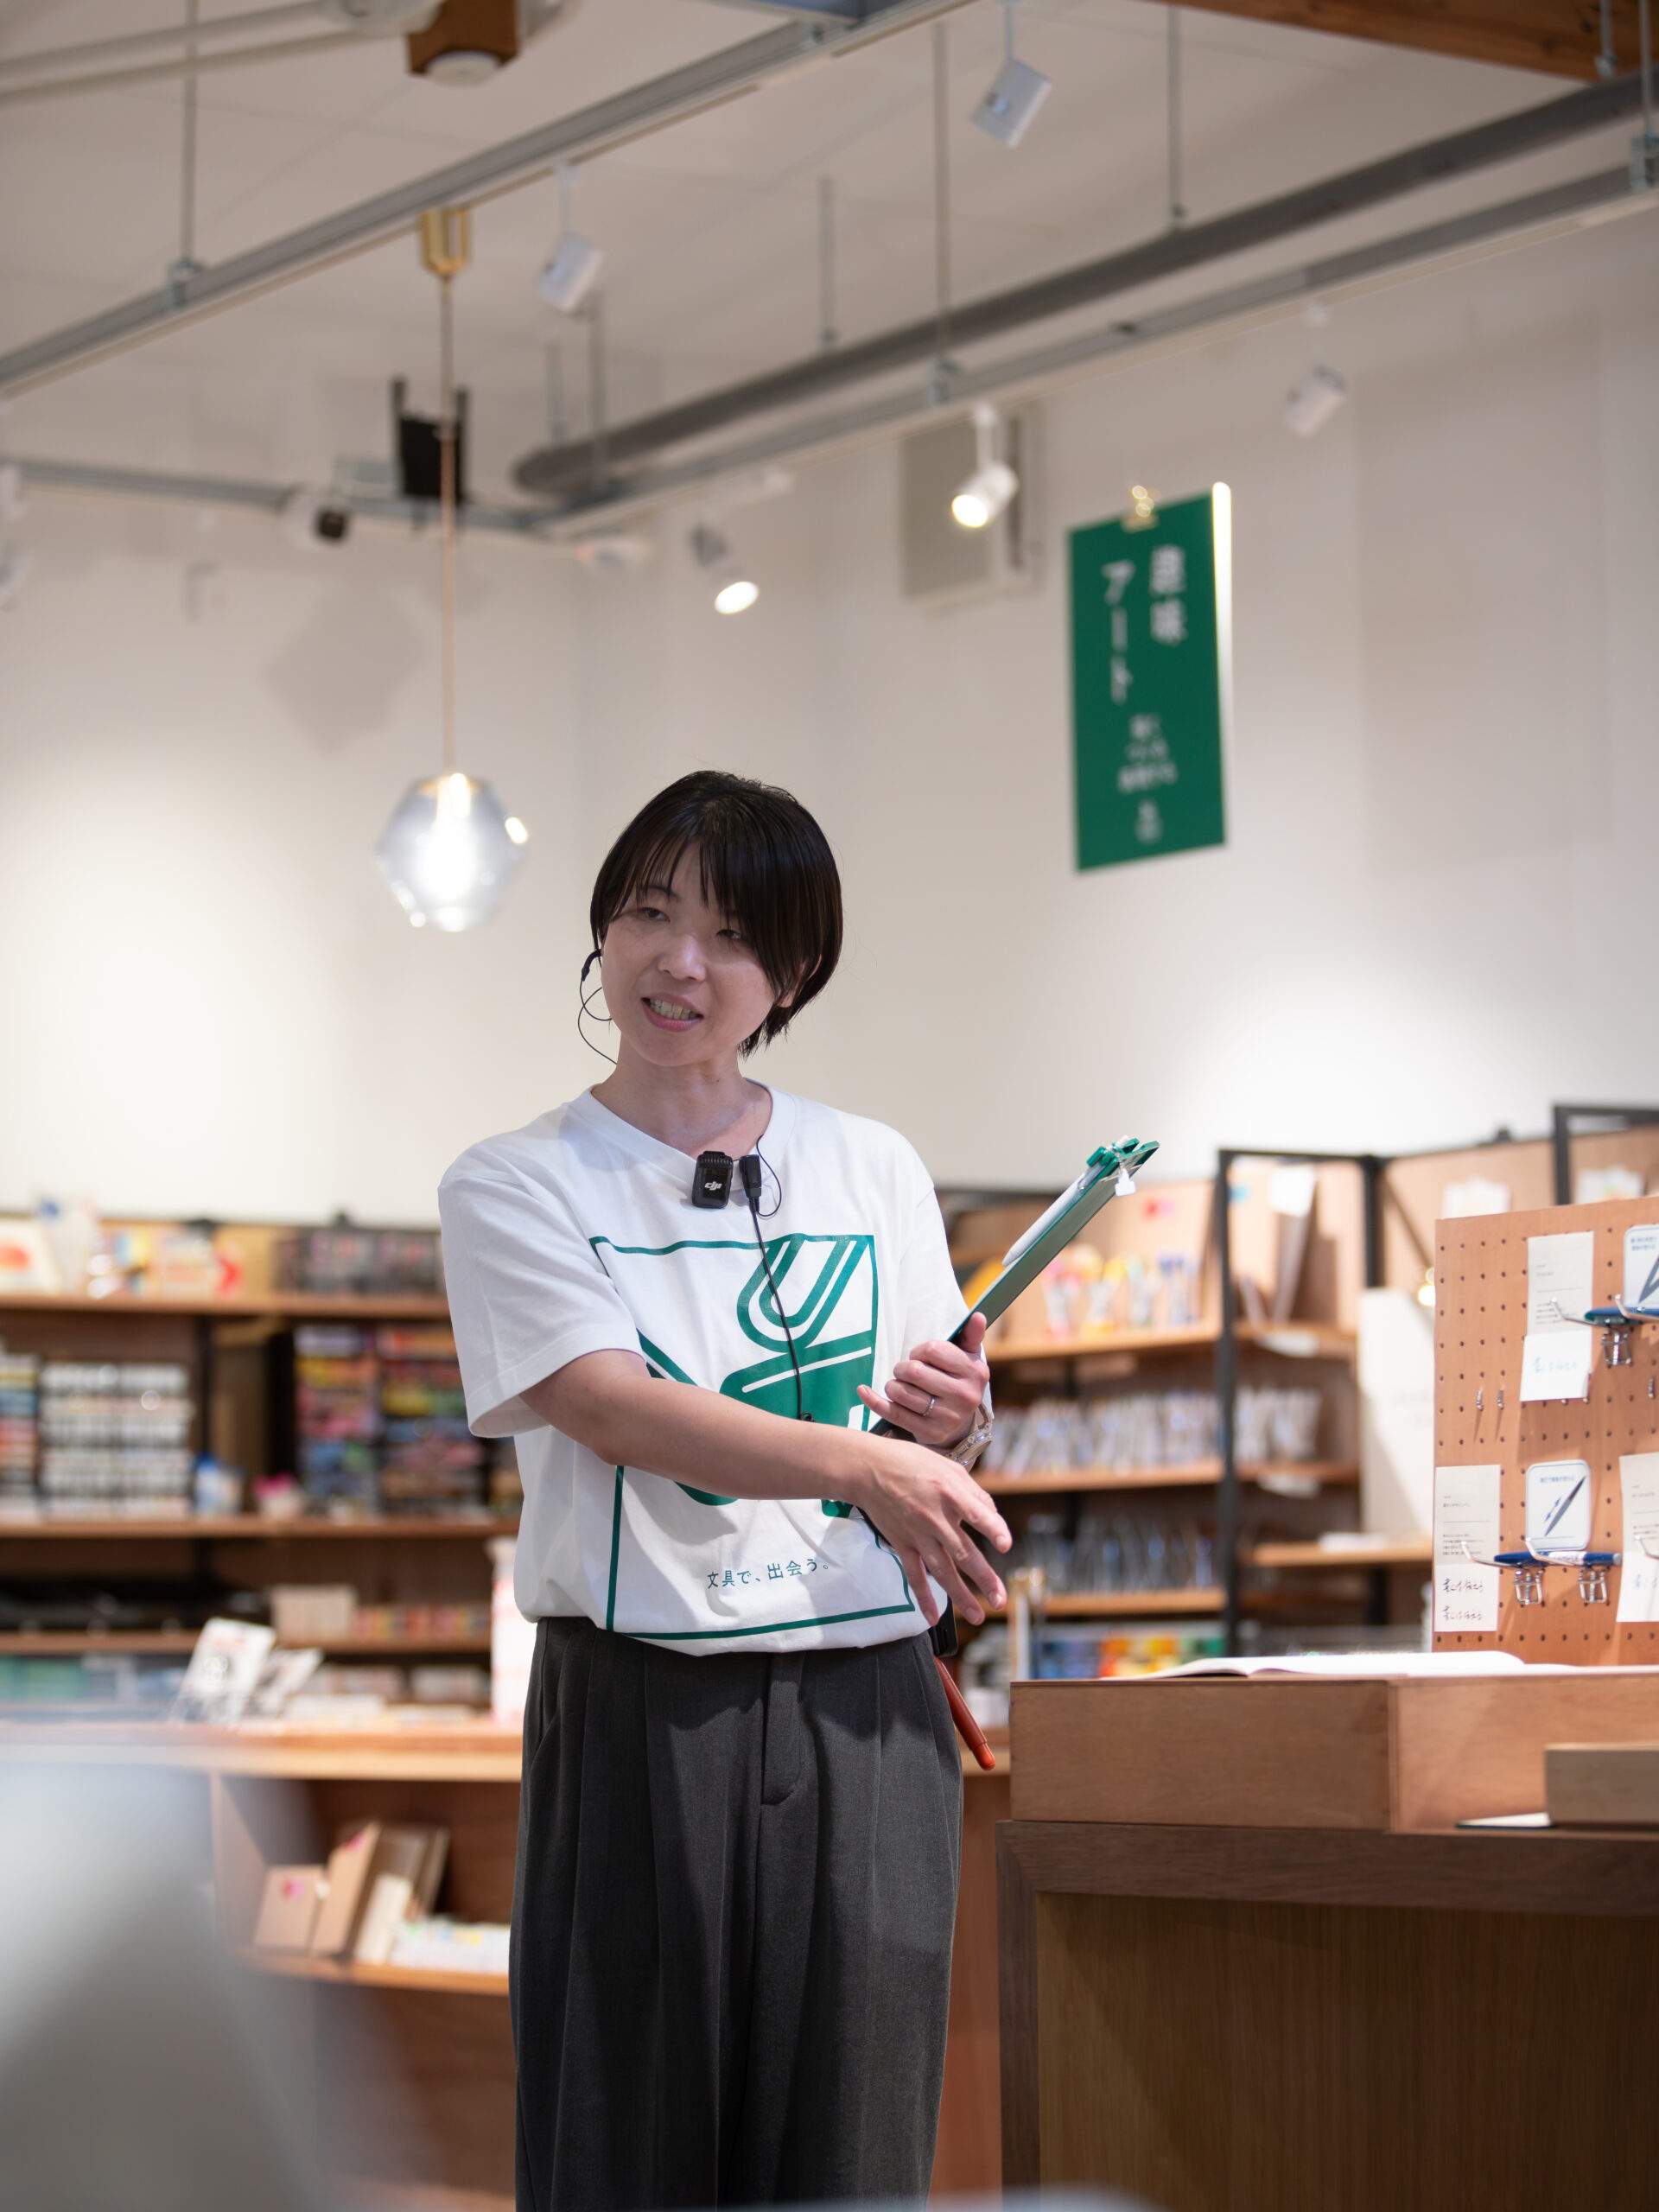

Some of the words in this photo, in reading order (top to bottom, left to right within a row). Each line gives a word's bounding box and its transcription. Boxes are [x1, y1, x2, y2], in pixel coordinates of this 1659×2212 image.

[707, 1558, 829, 1590] 文具で、出会う。
